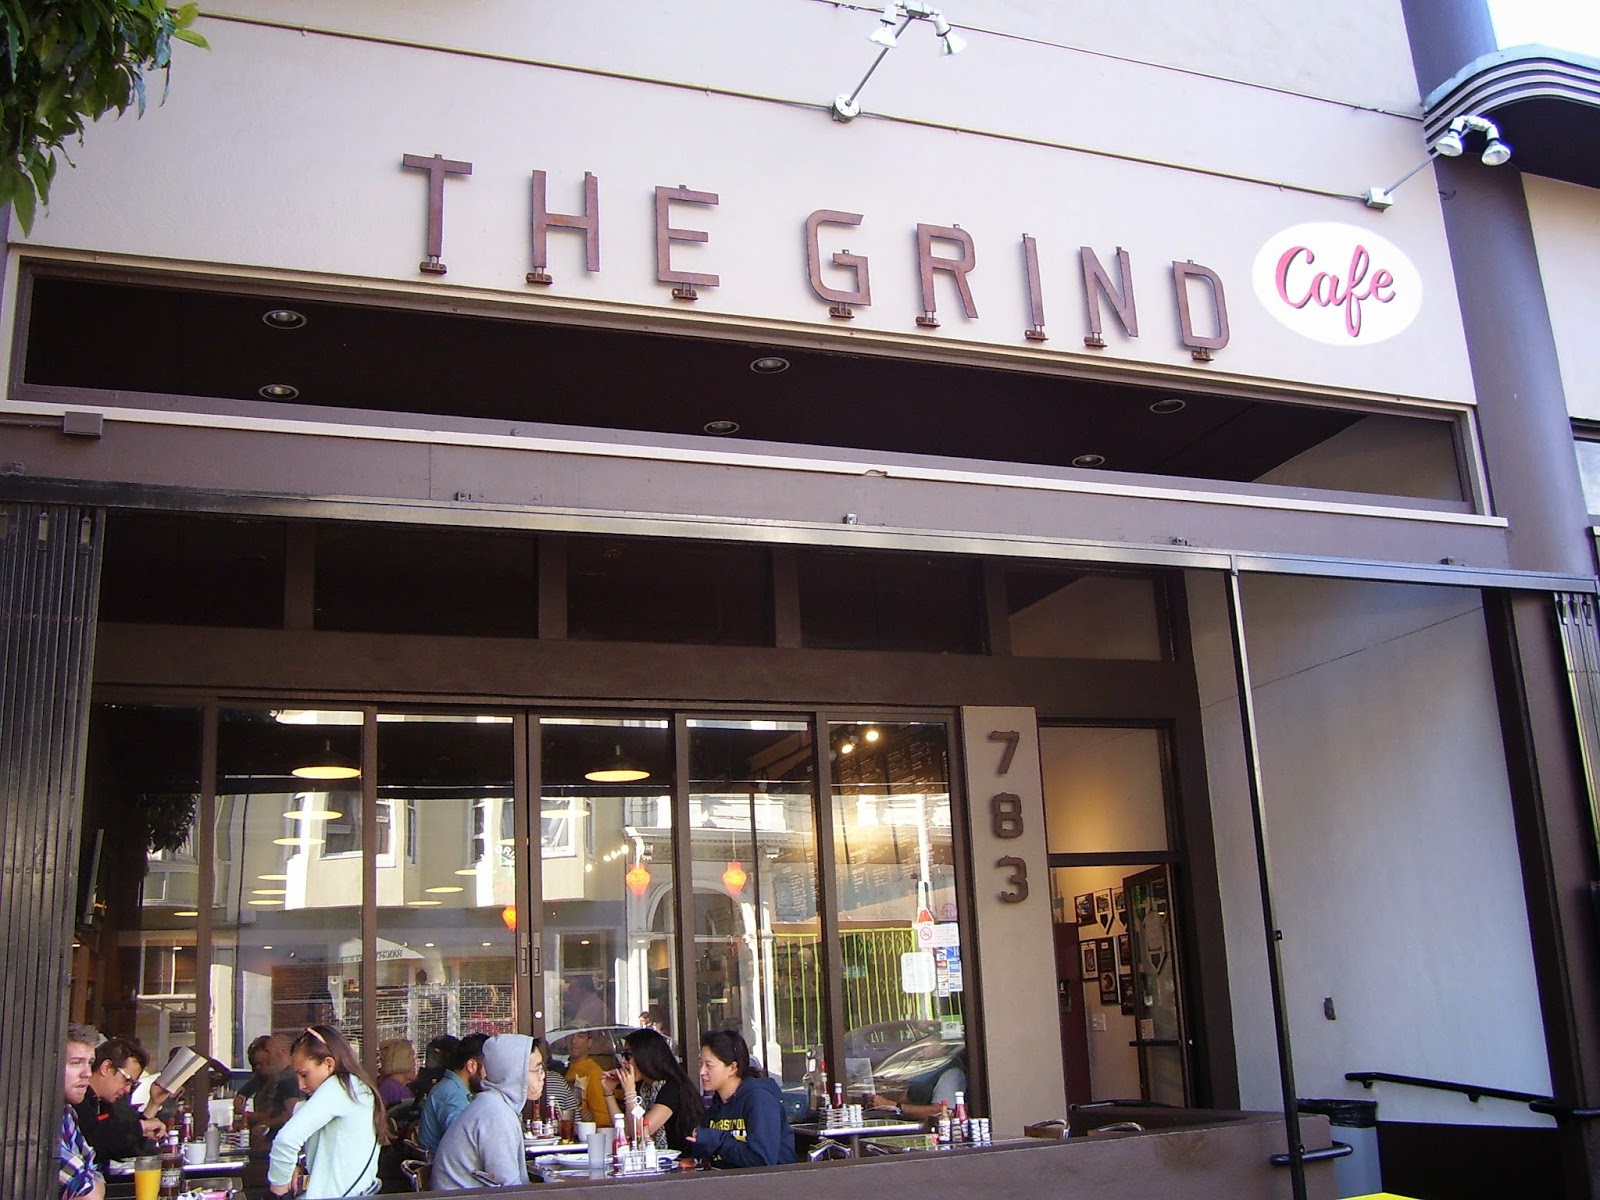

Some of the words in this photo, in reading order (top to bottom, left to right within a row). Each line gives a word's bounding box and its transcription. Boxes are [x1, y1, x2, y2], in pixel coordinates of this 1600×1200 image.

[402, 154, 720, 288] THE
[805, 209, 1231, 351] GRIND
[1275, 245, 1396, 337] Cafe
